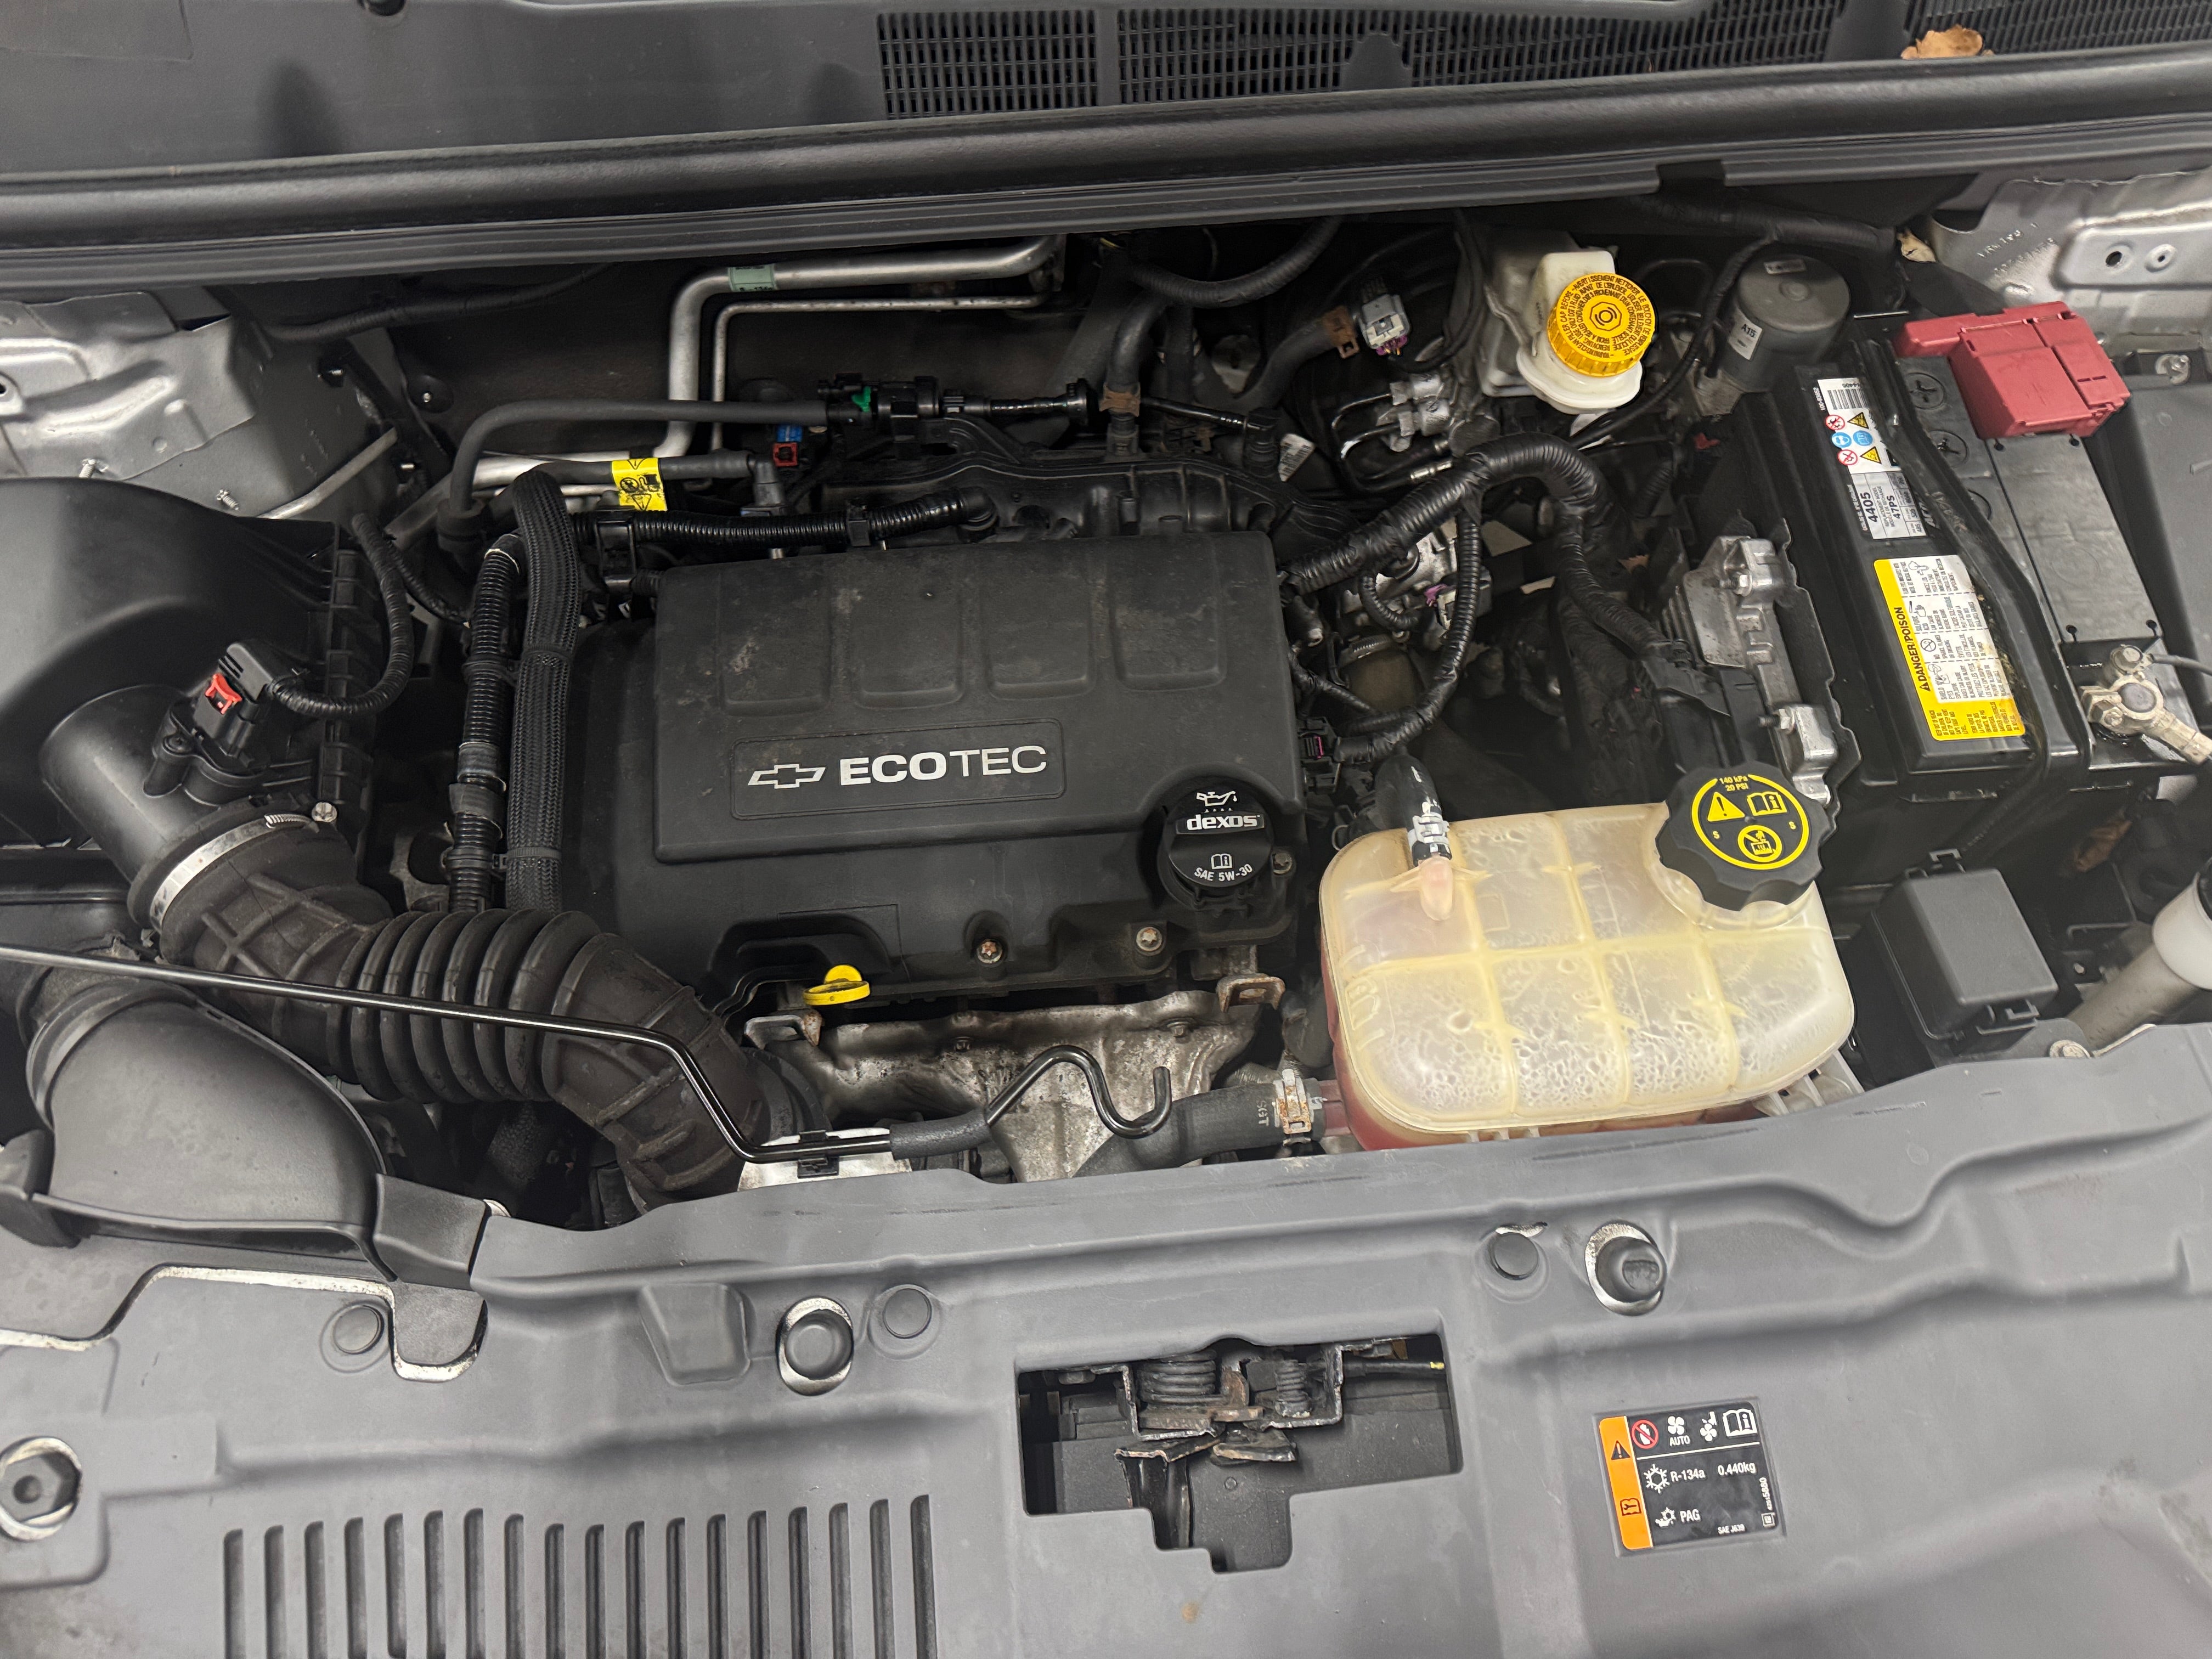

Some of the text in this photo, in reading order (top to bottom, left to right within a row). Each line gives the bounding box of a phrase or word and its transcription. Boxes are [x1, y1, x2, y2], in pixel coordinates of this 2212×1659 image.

[1560, 290, 1573, 309] BEFORE
[1568, 317, 1577, 329] ONLY
[1562, 324, 1575, 340] FILLER
[1573, 328, 1583, 339] USE
[1859, 492, 1878, 523] 4405
[1886, 495, 1901, 520] 47PS
[1893, 607, 1927, 681] DANGER/POISON
[839, 745, 1047, 786] ECOTEC
[1719, 775, 1749, 785] 140 kPa
[1725, 782, 1749, 792] 20 PSI
[1186, 814, 1258, 831] dexos
[1194, 863, 1253, 882] SAE 5W-30
[1669, 1435, 1690, 1447] AUTO
[1670, 1461, 1757, 1482] R-134a 0.440kg
[1679, 1508, 1701, 1523] PAG
[1717, 1525, 1730, 1534] SAE
